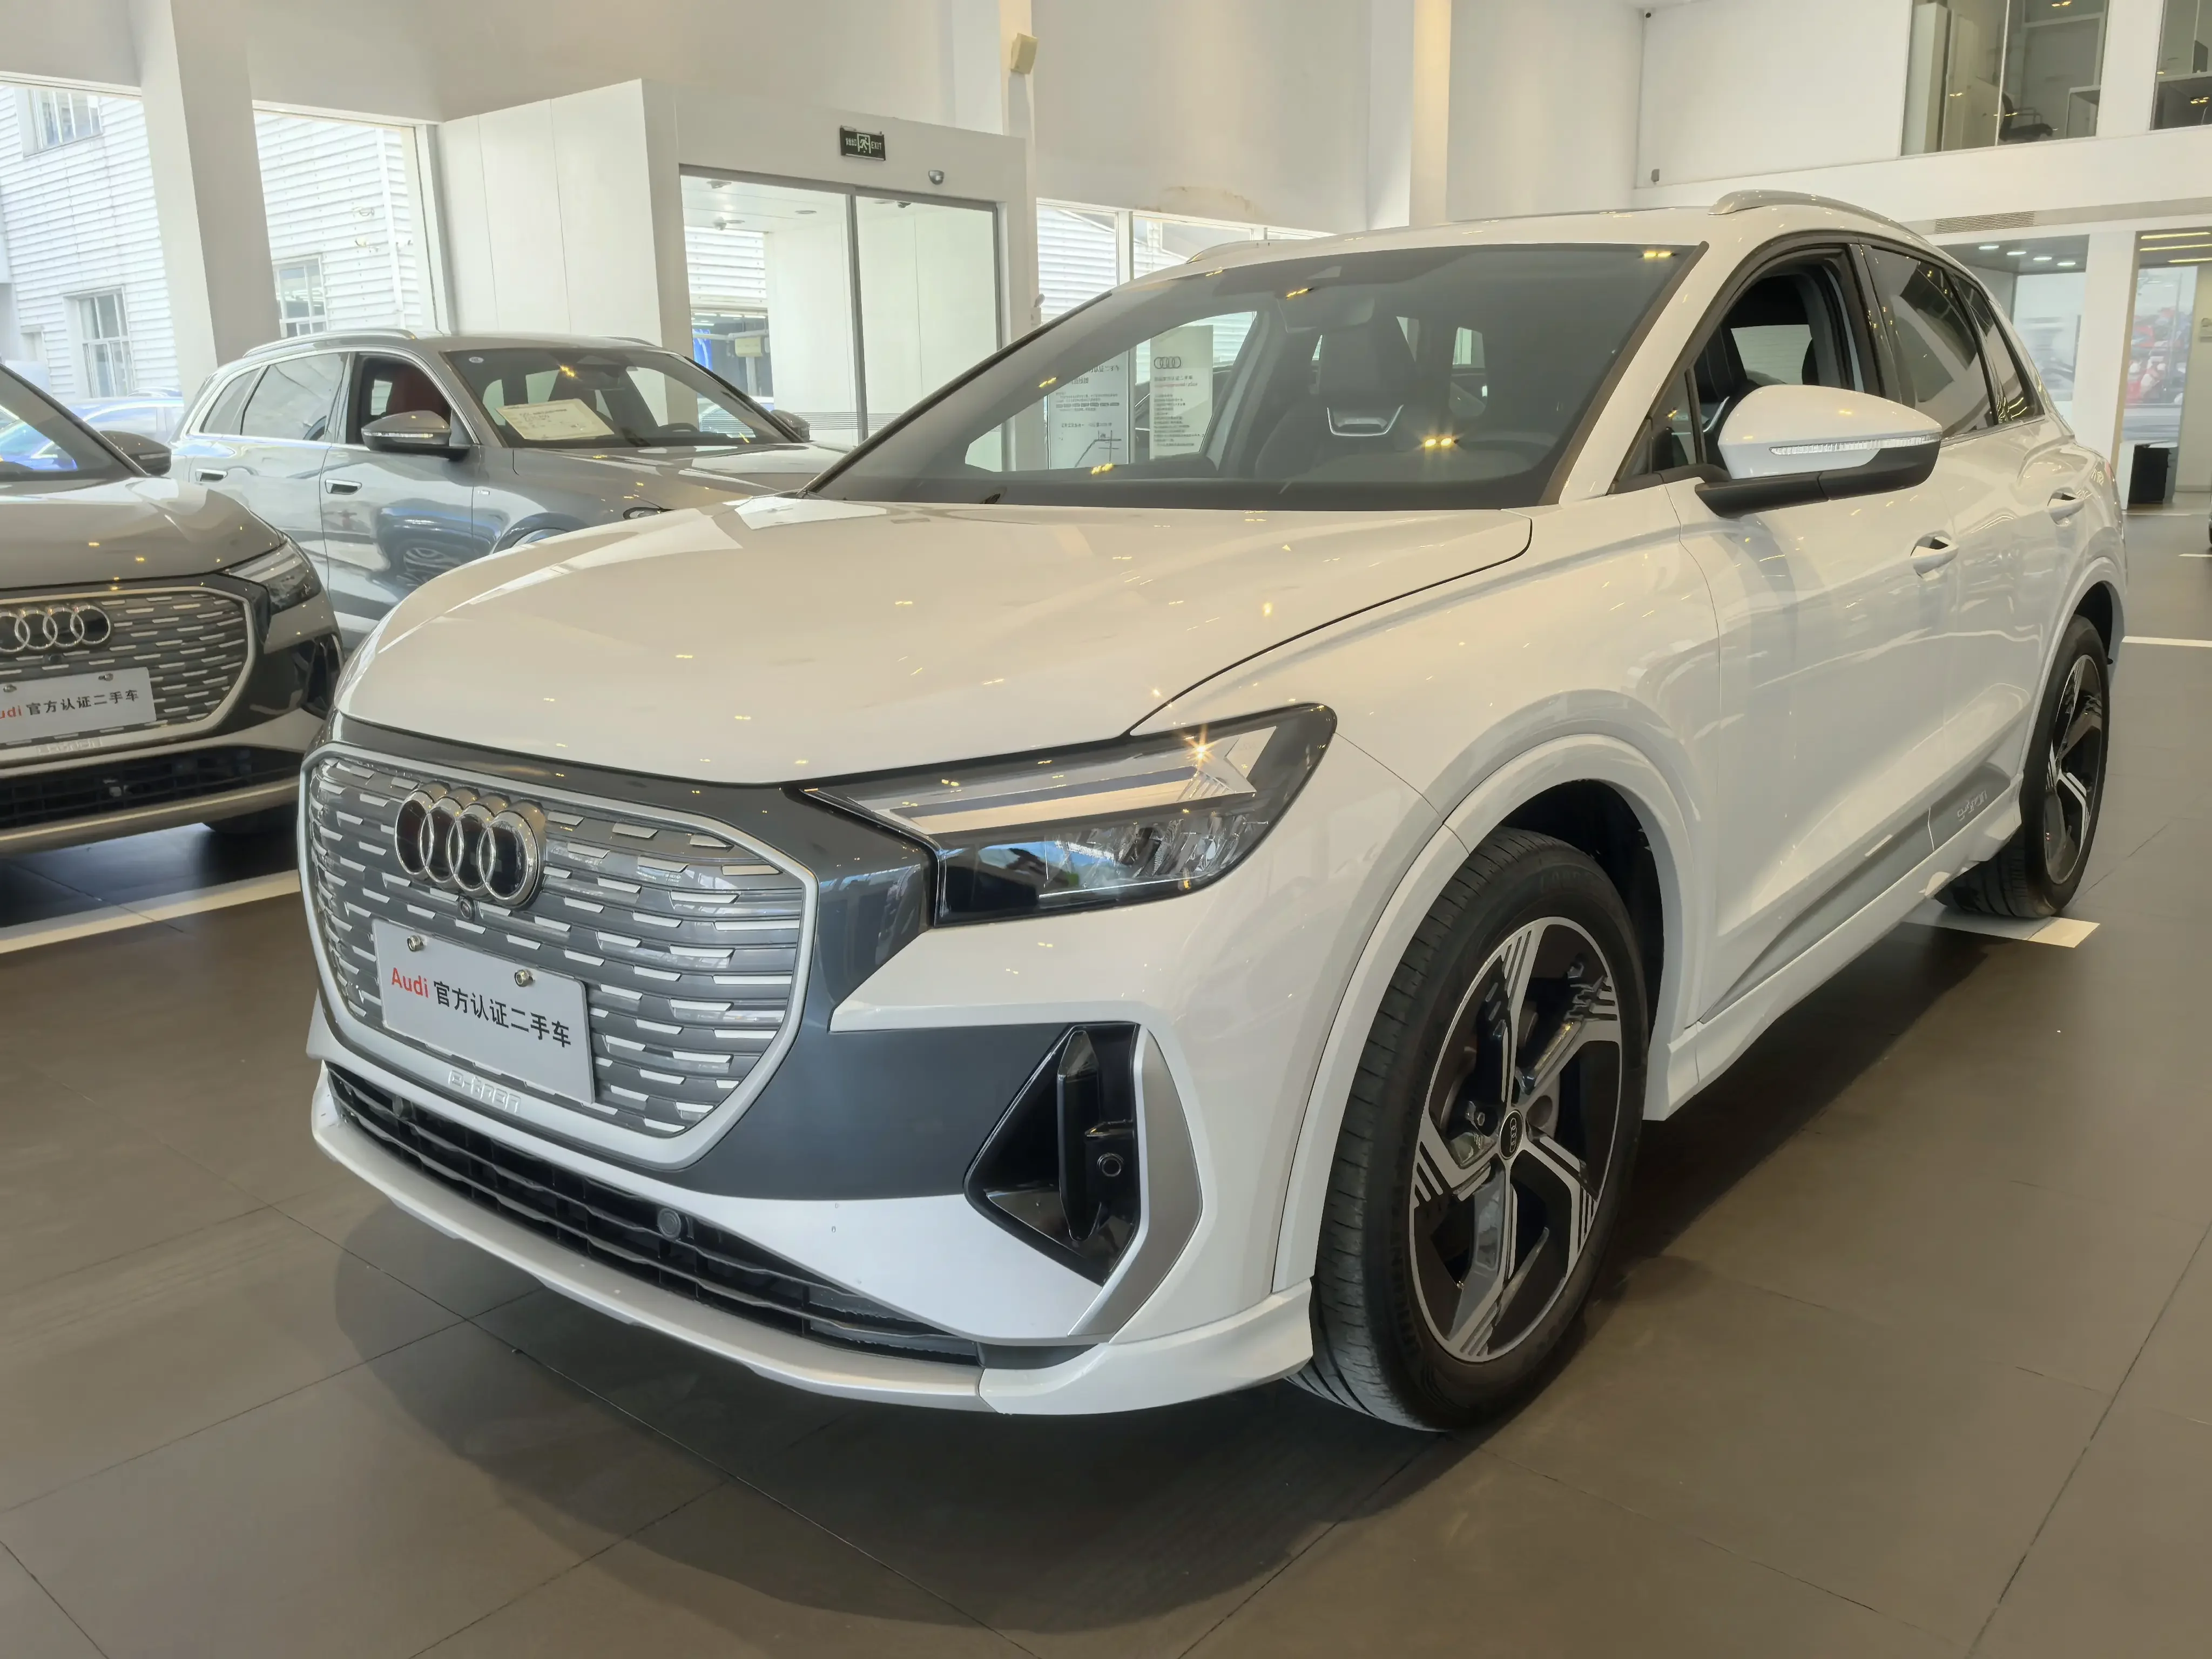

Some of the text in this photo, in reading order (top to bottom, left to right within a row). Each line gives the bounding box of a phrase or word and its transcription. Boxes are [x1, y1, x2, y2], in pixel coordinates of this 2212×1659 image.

[871, 141, 882, 150] EXIT
[26, 689, 139, 716] 官方认证二手车
[391, 967, 571, 1048] Audi 官方认证二手车
